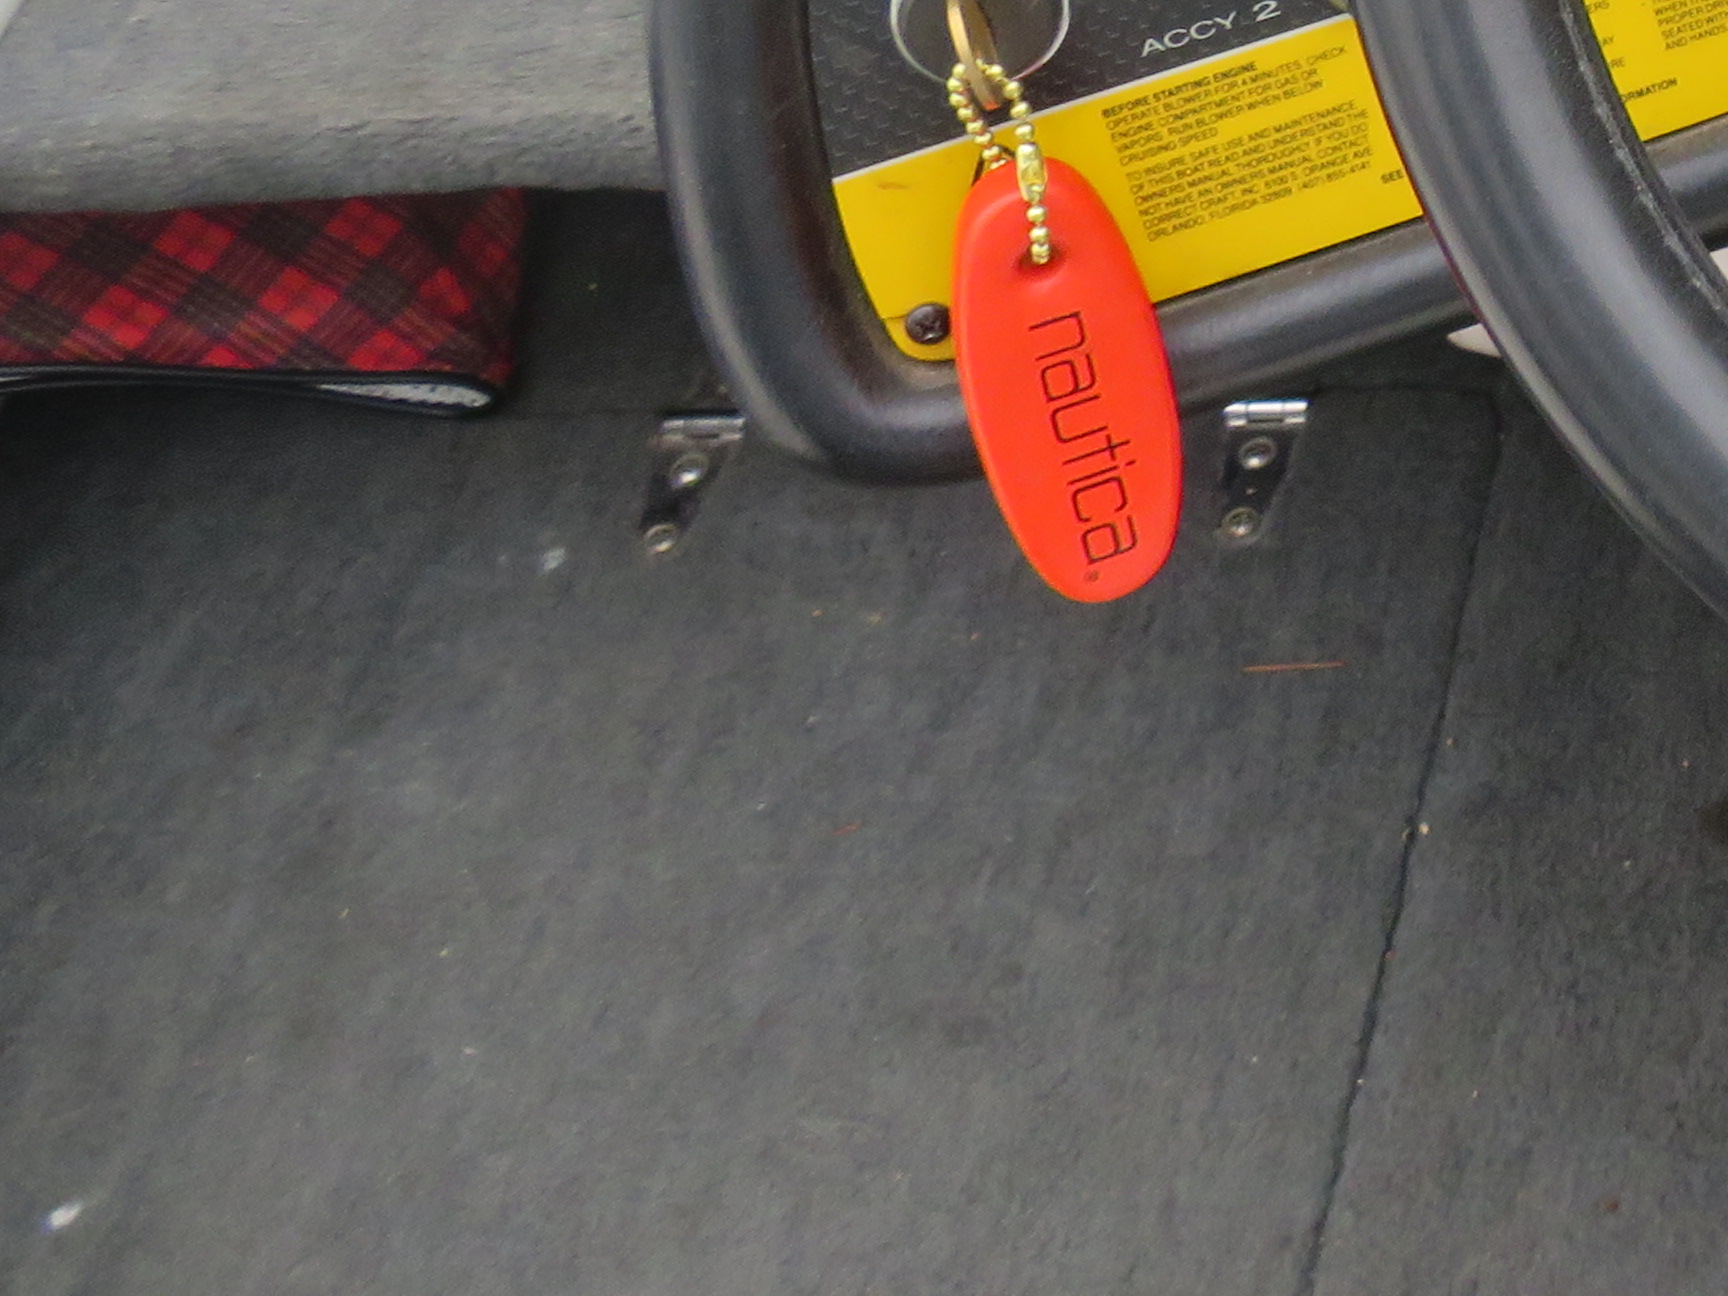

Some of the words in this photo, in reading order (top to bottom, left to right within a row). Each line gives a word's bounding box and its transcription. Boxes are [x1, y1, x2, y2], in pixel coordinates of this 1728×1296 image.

[1141, 13, 1237, 58] ACCY
[1253, 0, 1282, 22] 2
[1101, 95, 1150, 118] BEFORE
[1152, 76, 1210, 102] STARTING
[1212, 61, 1257, 83] ENGINE
[1029, 310, 1139, 565] nautica
